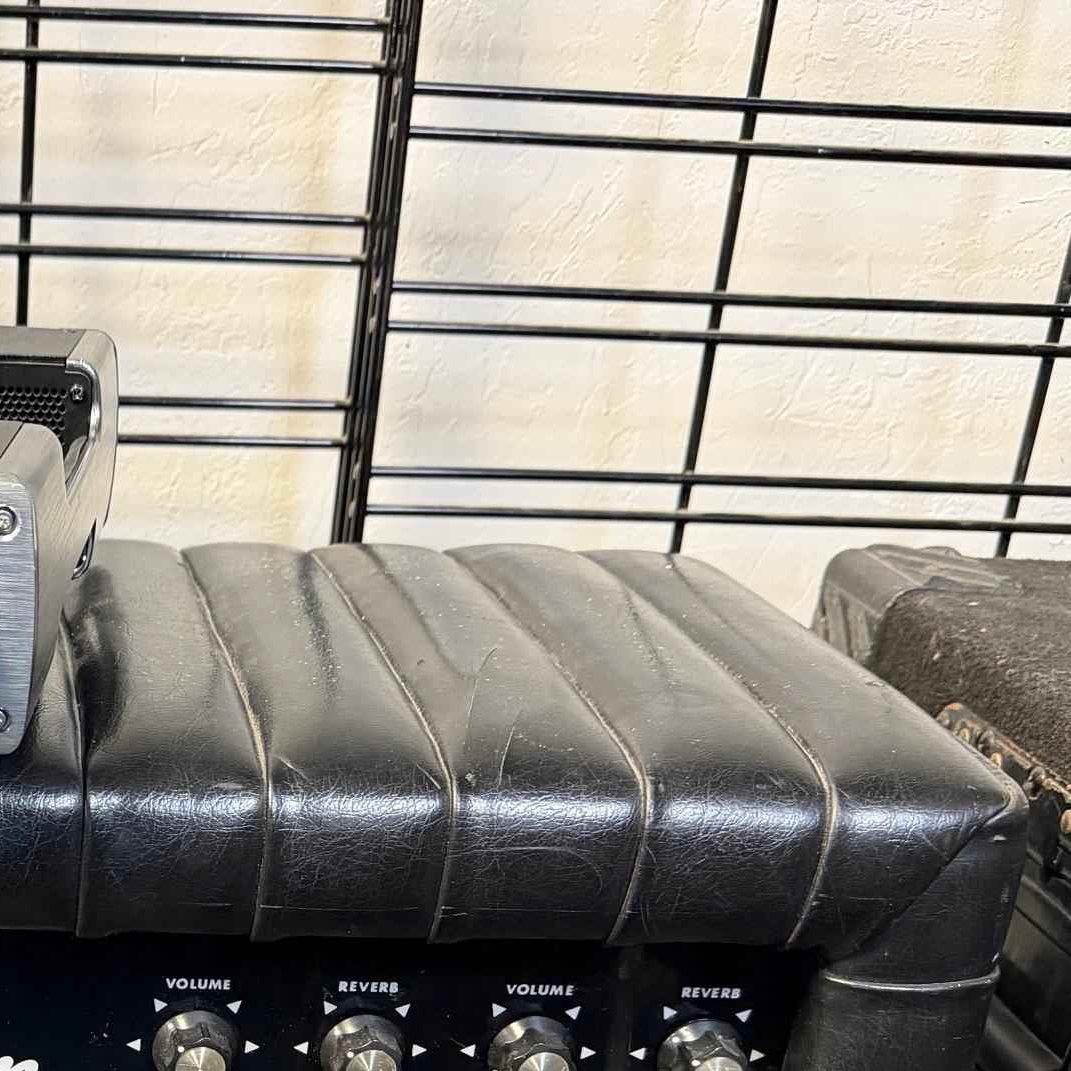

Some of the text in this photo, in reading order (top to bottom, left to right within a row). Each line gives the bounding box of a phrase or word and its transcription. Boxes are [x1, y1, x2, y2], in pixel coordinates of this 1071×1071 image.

[166, 977, 231, 991] VOLUME
[338, 980, 399, 993] REVERB
[506, 984, 575, 996] VOLUME
[681, 987, 741, 999] REVERB
